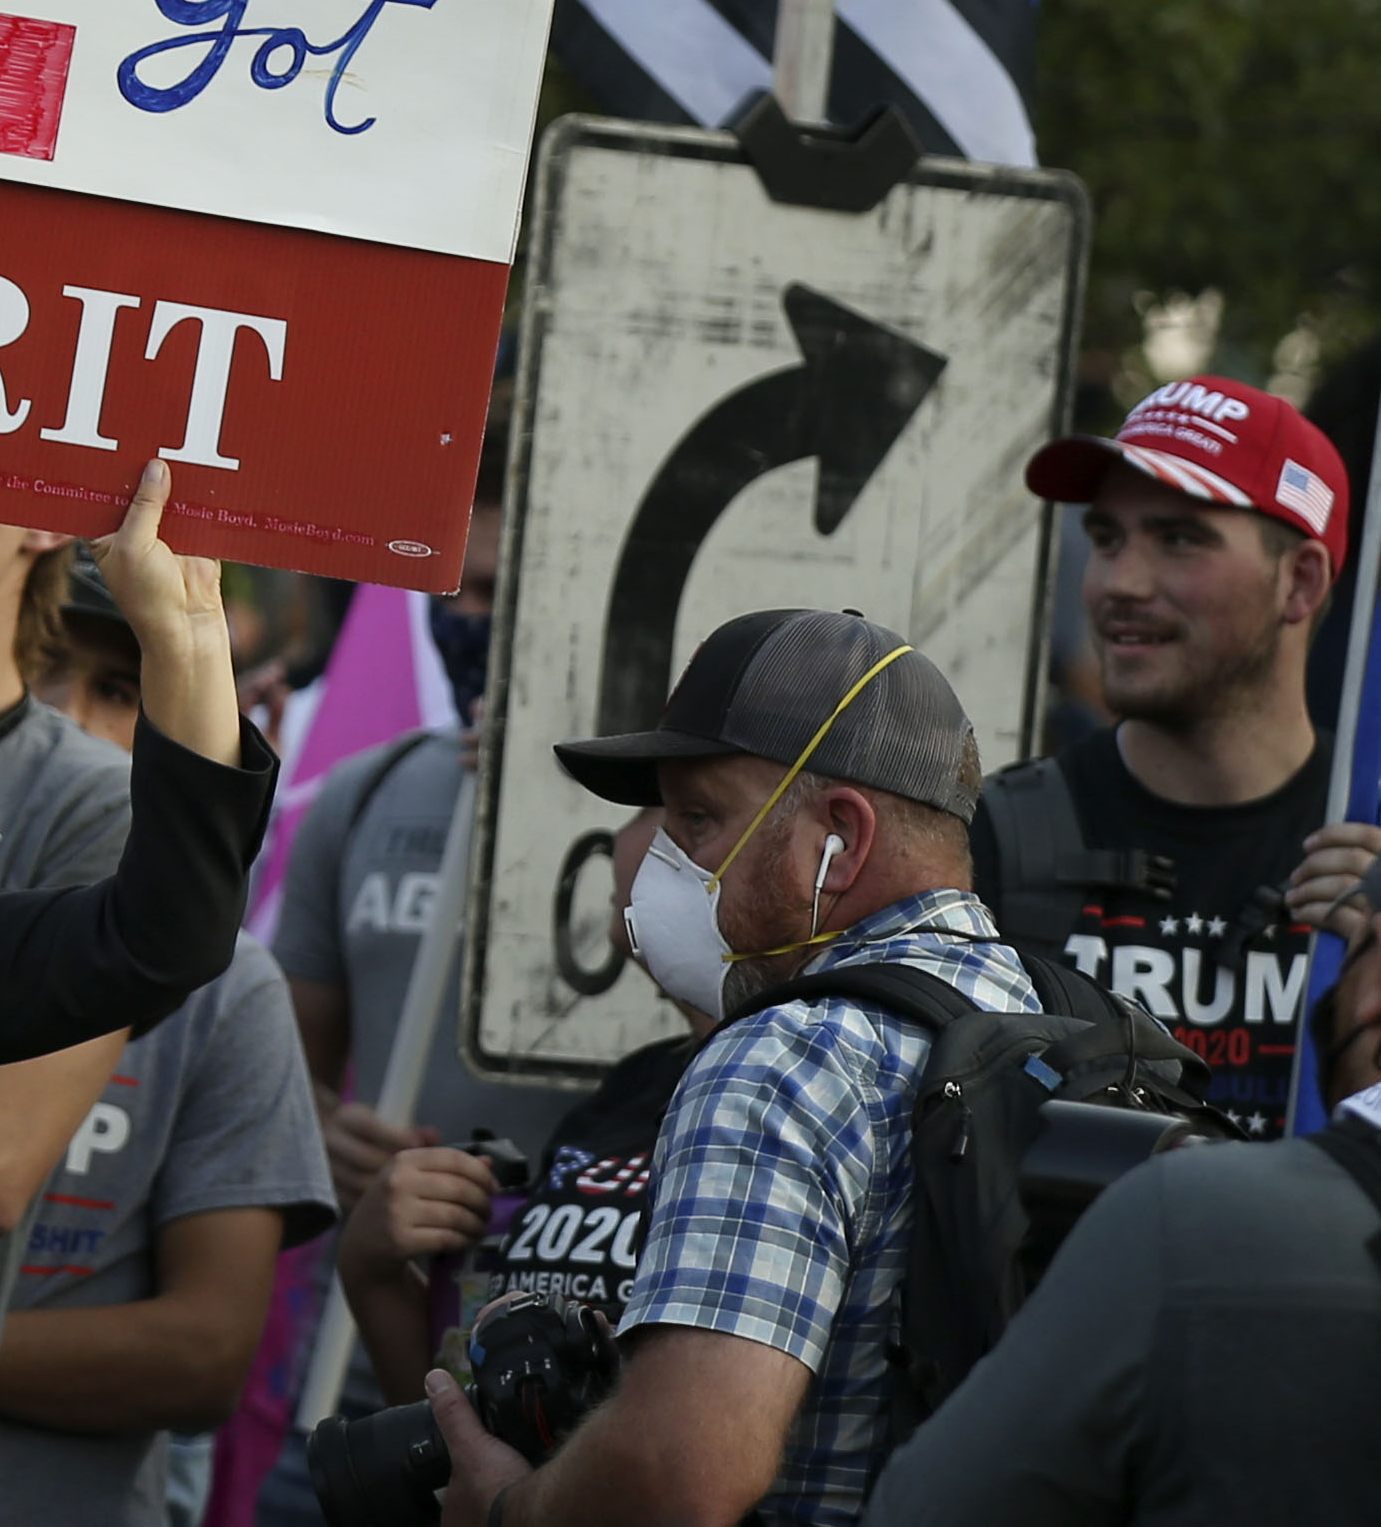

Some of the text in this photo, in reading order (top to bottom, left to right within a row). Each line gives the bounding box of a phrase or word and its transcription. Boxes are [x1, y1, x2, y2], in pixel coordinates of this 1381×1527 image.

[6, 475, 30, 491] the
[32, 479, 112, 505] Committee
[114, 494, 130, 507] to
[172, 502, 215, 521] Mosie
[216, 508, 258, 529] Boyd.
[506, 1270, 609, 1302] AMERICA
